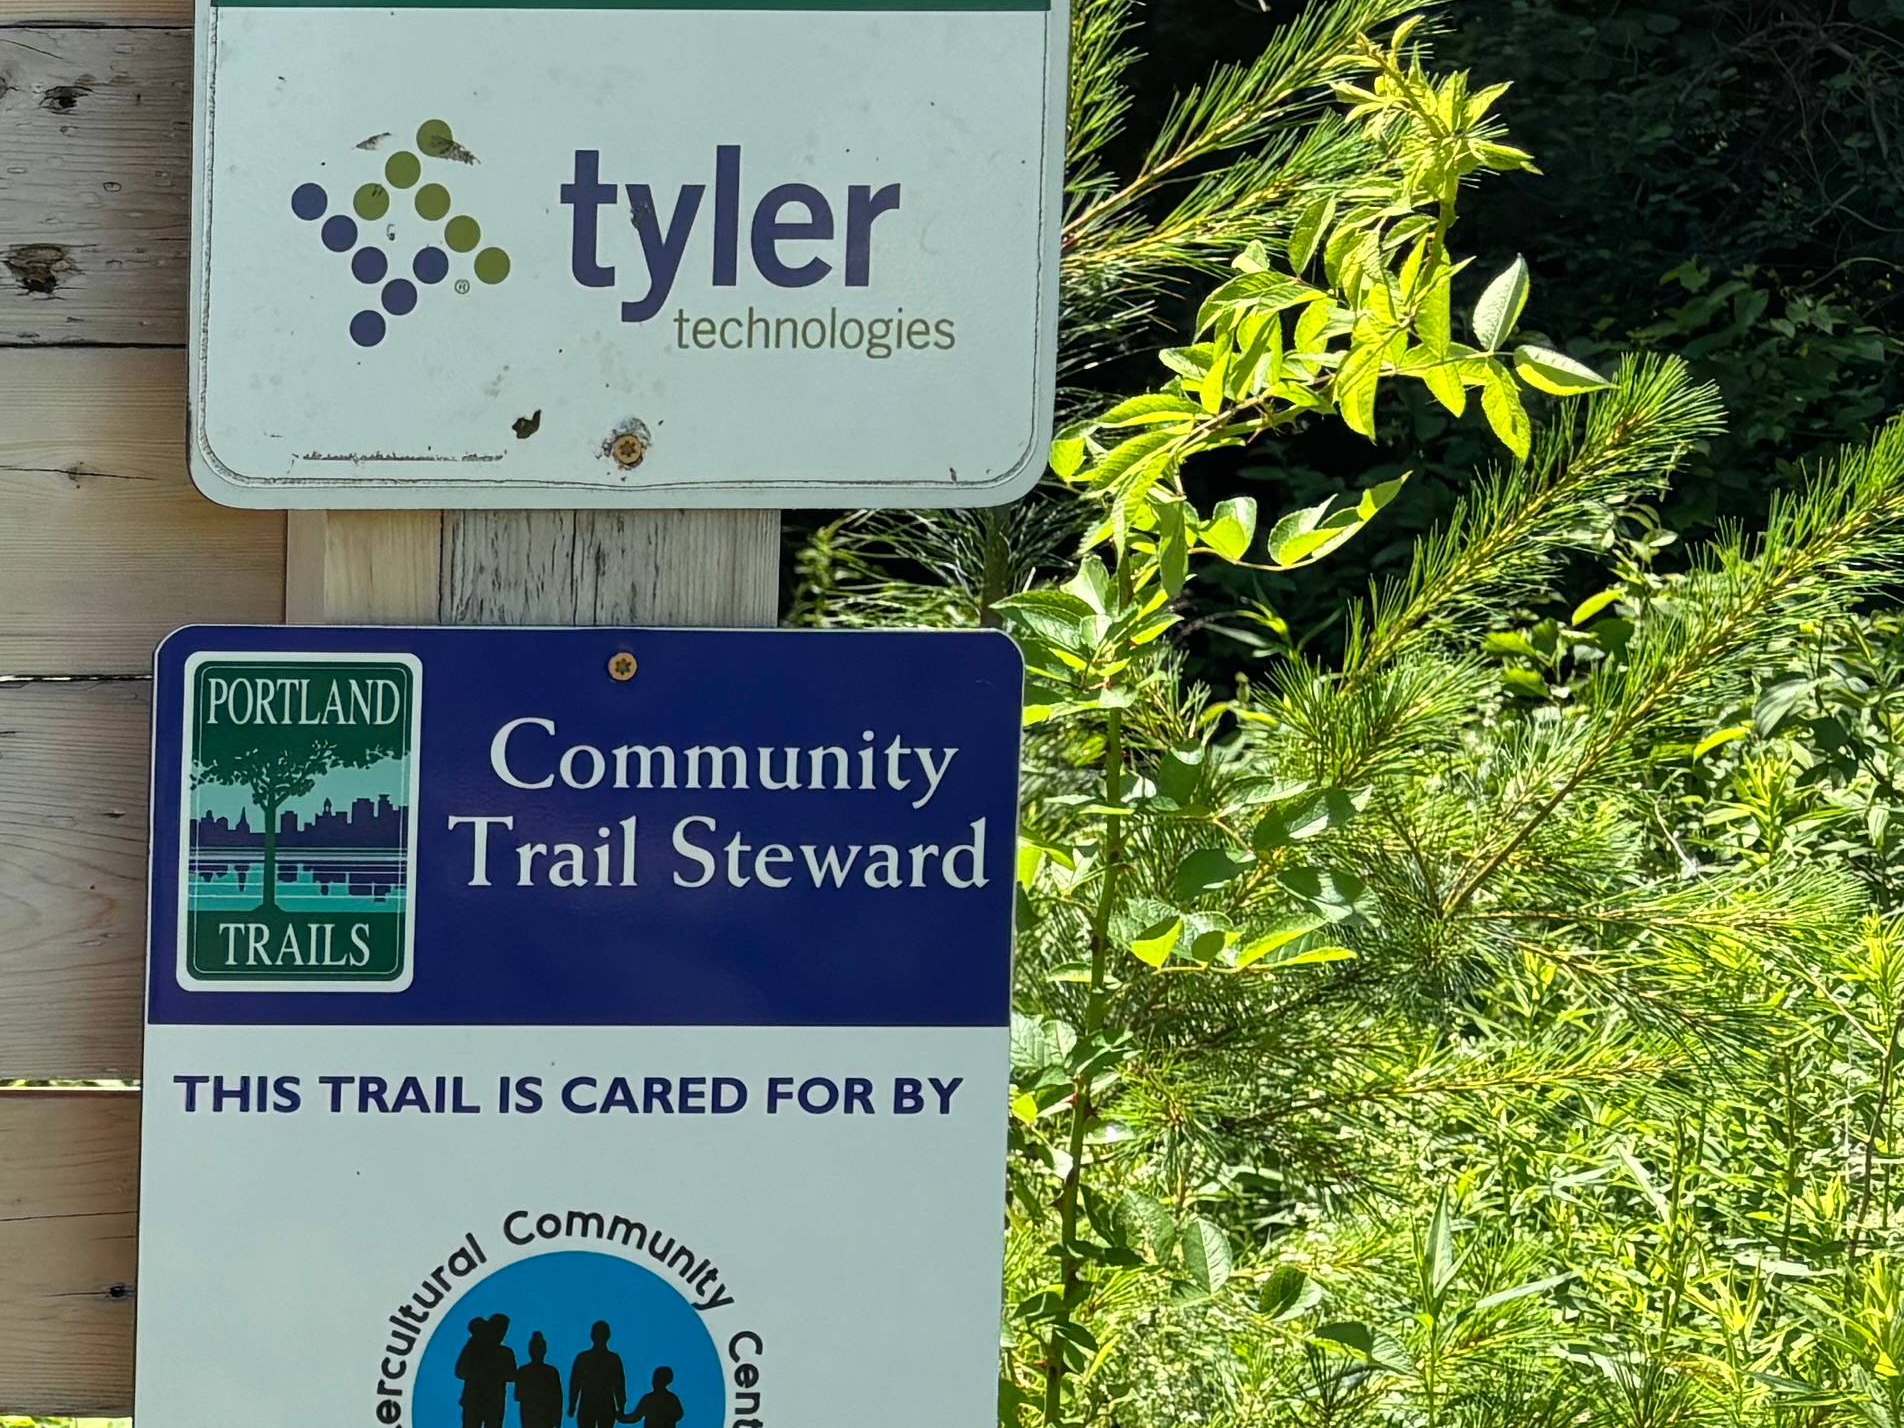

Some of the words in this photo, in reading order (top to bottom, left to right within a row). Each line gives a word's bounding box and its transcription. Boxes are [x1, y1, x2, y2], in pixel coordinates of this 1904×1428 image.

[559, 145, 901, 324] tyler
[673, 307, 957, 359] technologies
[206, 677, 401, 728] PORTLAND
[490, 716, 960, 809] Community
[447, 814, 637, 890] Trail
[672, 815, 991, 891] Steward
[218, 922, 371, 968] TRAILS
[173, 1073, 302, 1115] THIS
[318, 1074, 480, 1115] TRAIL
[498, 1075, 544, 1115] IS
[560, 1075, 749, 1115] CARED
[765, 1076, 883, 1116] FOR
[894, 1077, 965, 1116] BY
[503, 1209, 735, 1312] Community
